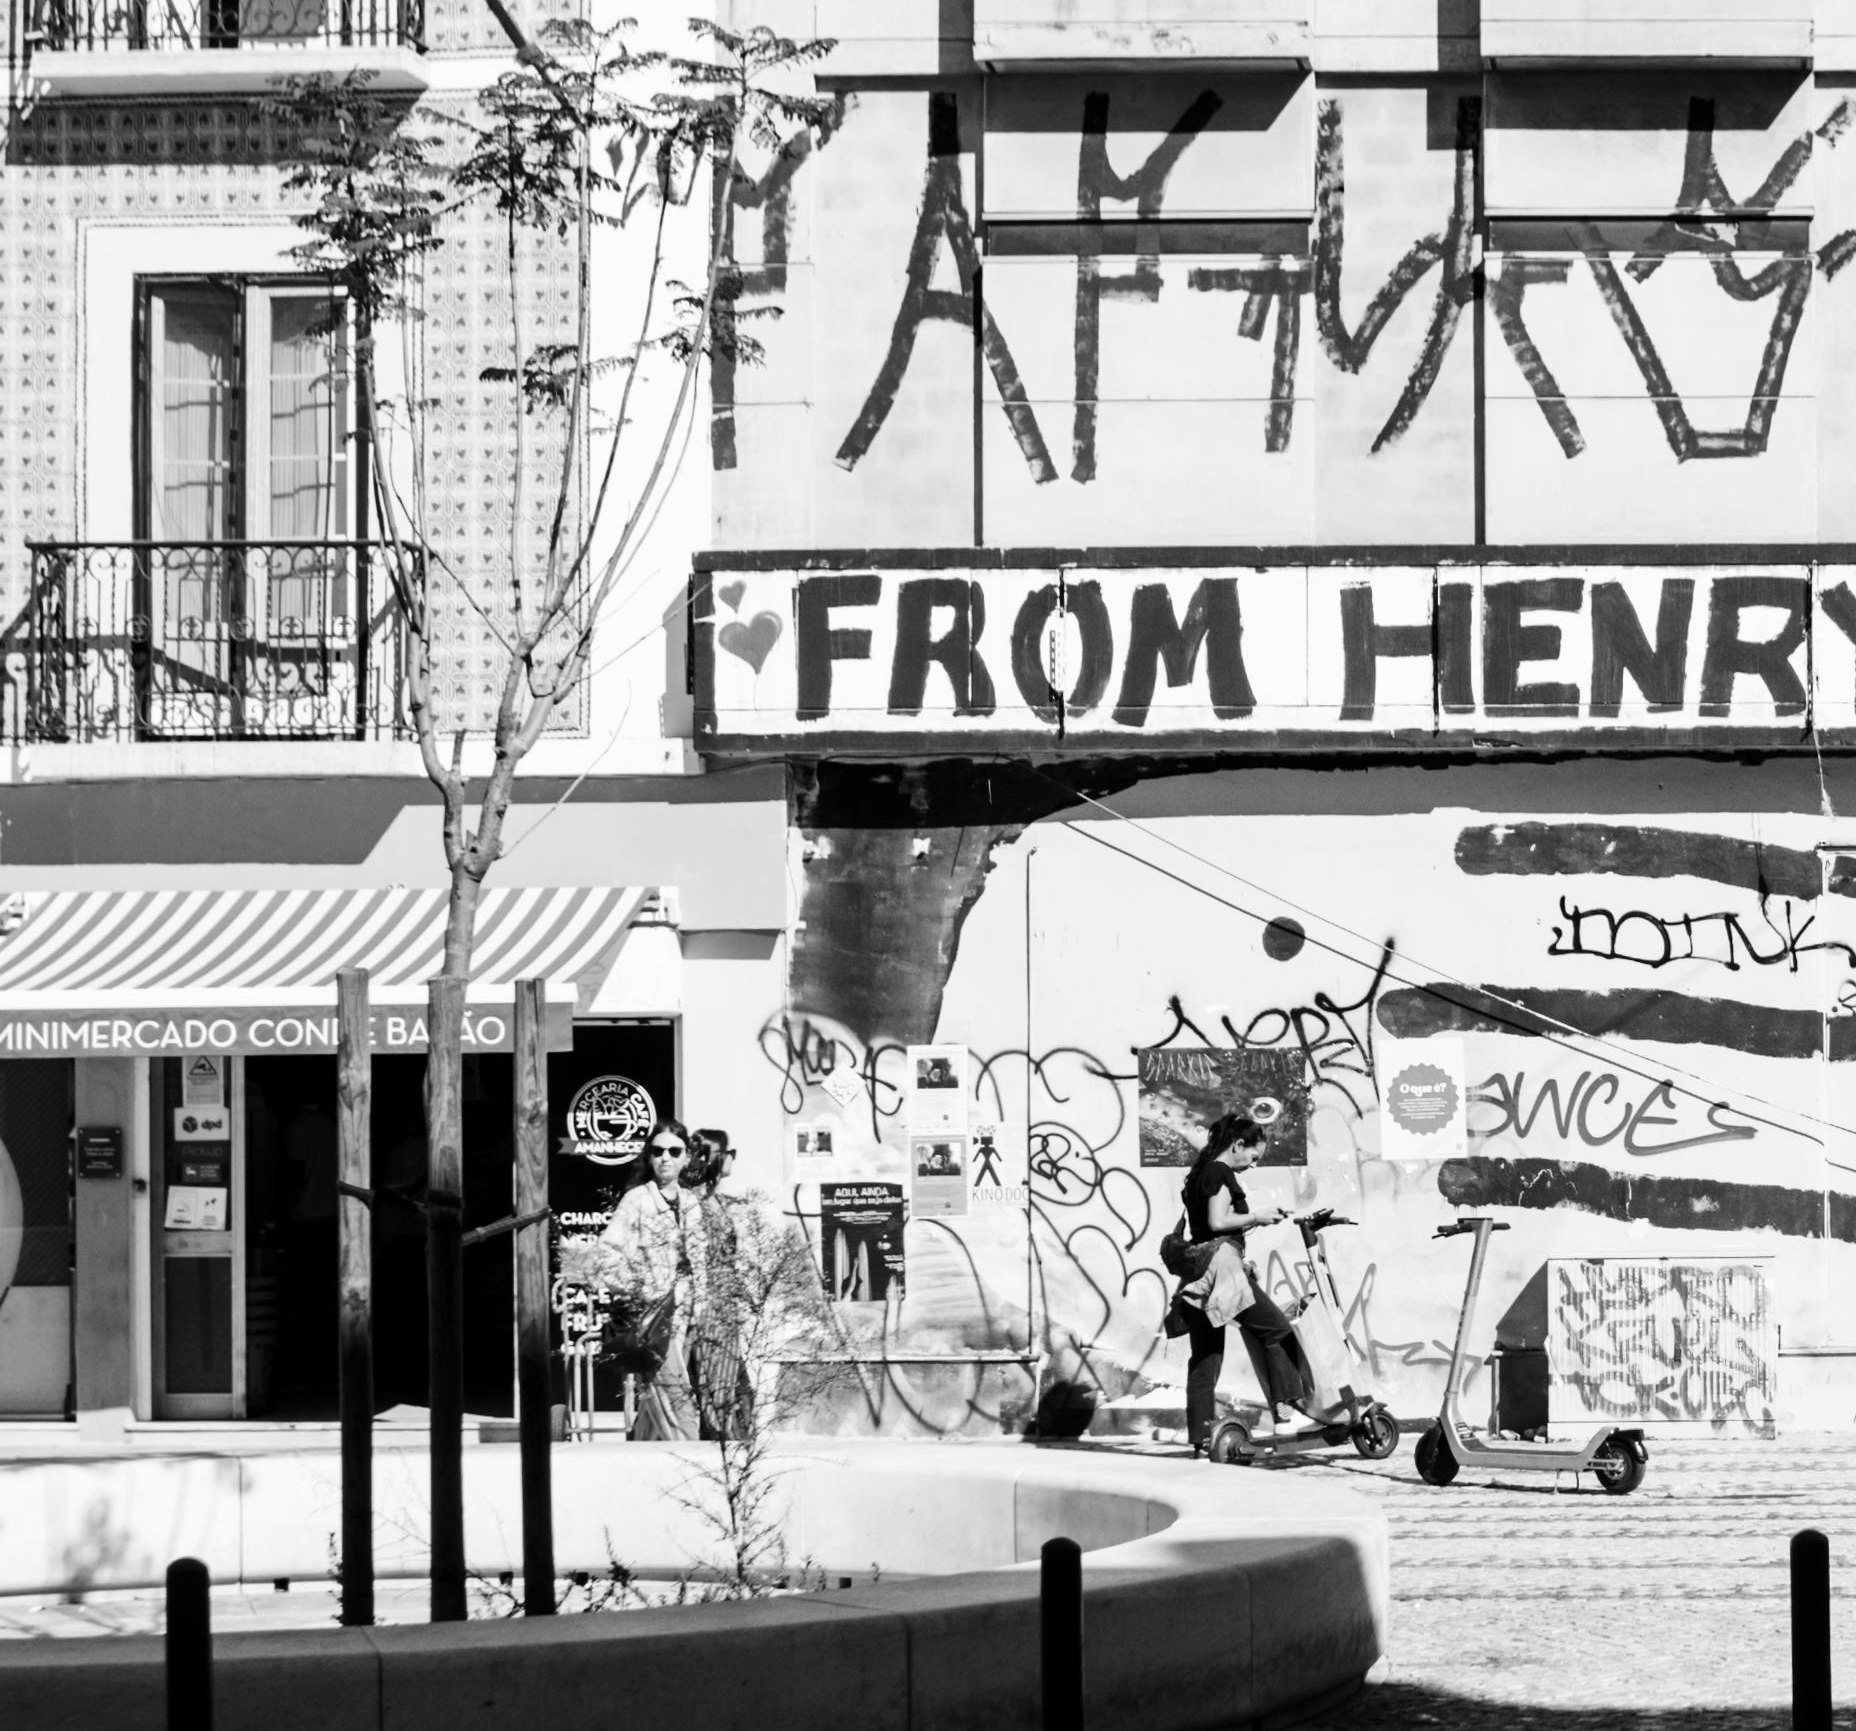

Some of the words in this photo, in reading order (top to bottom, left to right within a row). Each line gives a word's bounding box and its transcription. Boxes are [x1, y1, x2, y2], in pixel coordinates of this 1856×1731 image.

[794, 574, 1258, 728] FROM
[248, 1017, 377, 1048] CON
[387, 1011, 506, 1045] BAÃO
[575, 1082, 629, 1129] MERCEARIA
[574, 1141, 646, 1153] AMANHECE
[560, 1211, 614, 1225] CHARC
